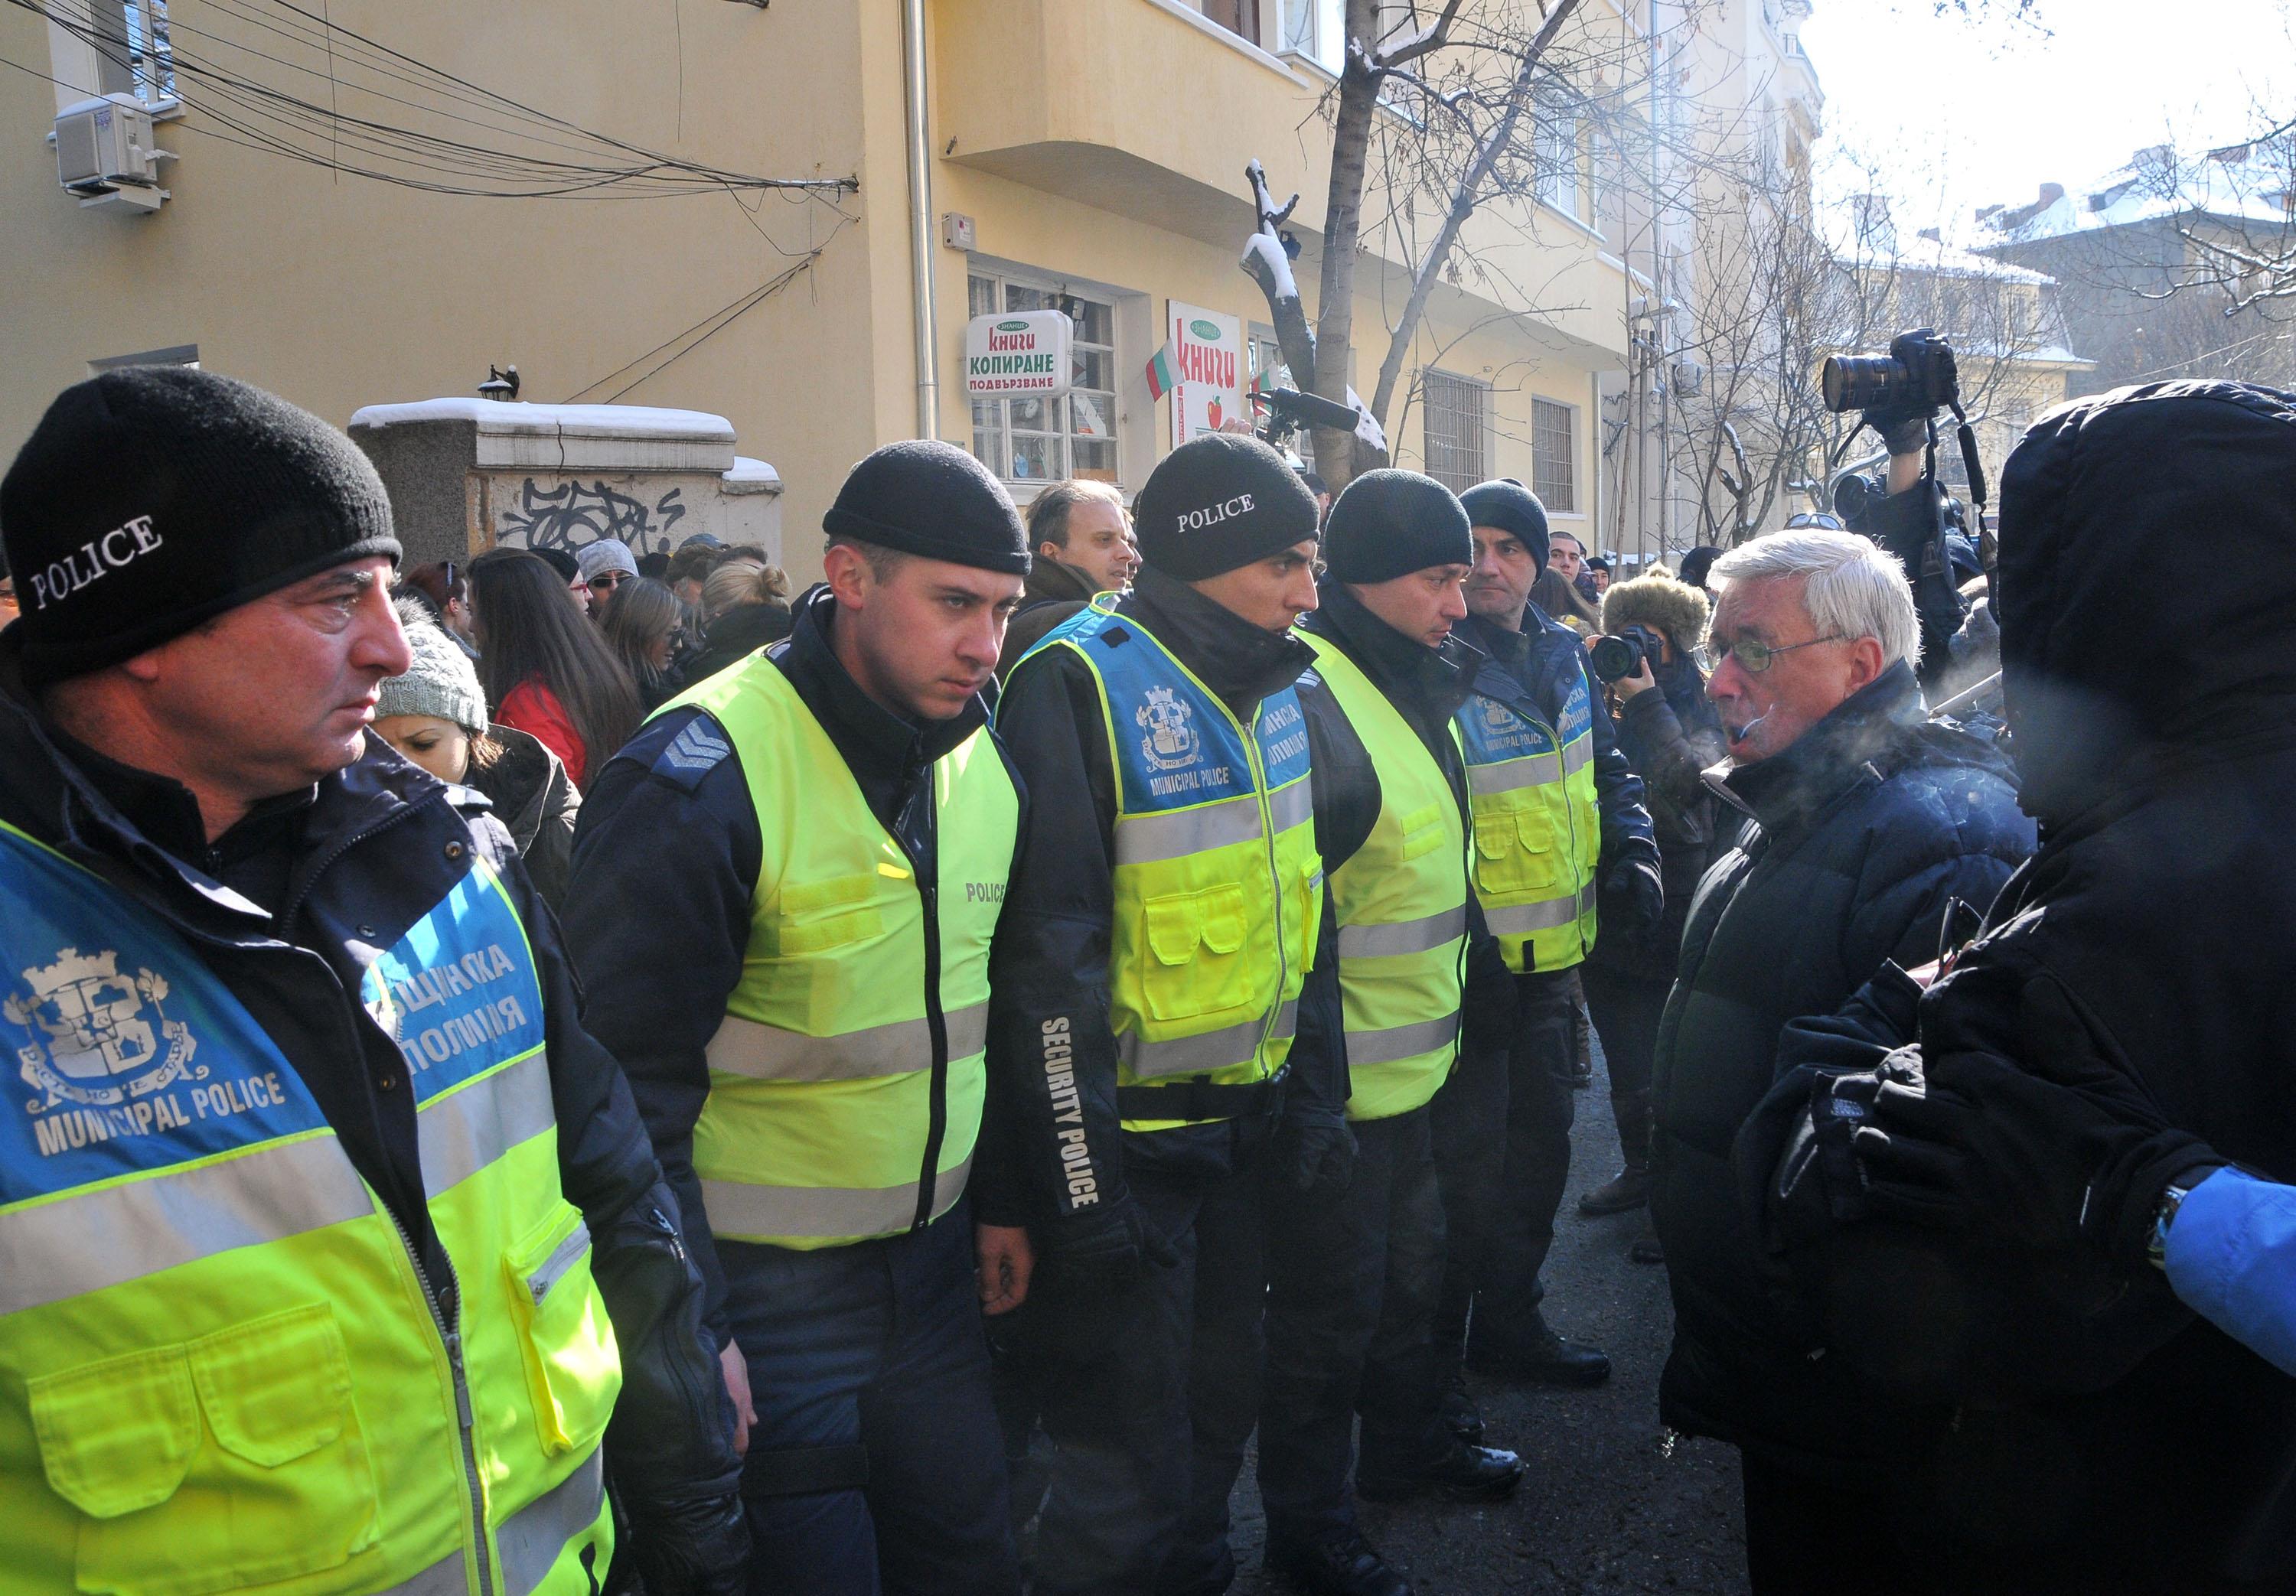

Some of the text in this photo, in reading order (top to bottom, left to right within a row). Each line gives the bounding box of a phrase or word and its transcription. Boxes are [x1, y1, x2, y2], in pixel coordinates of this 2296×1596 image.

[989, 327, 1035, 351] книги
[970, 354, 1054, 375] КОПИРАНЕ
[969, 377, 1053, 390] ПОДВЪРЗВАНЕ
[1177, 493, 1255, 533] POLICE
[30, 515, 163, 610] POLICE
[1520, 732, 1542, 746] POLICE
[1150, 767, 1229, 796] MUNICIPAL POLICE
[34, 1072, 285, 1156] MUNICIPAL POLICE
[1042, 1016, 1099, 1209] SECURITY POLICE
